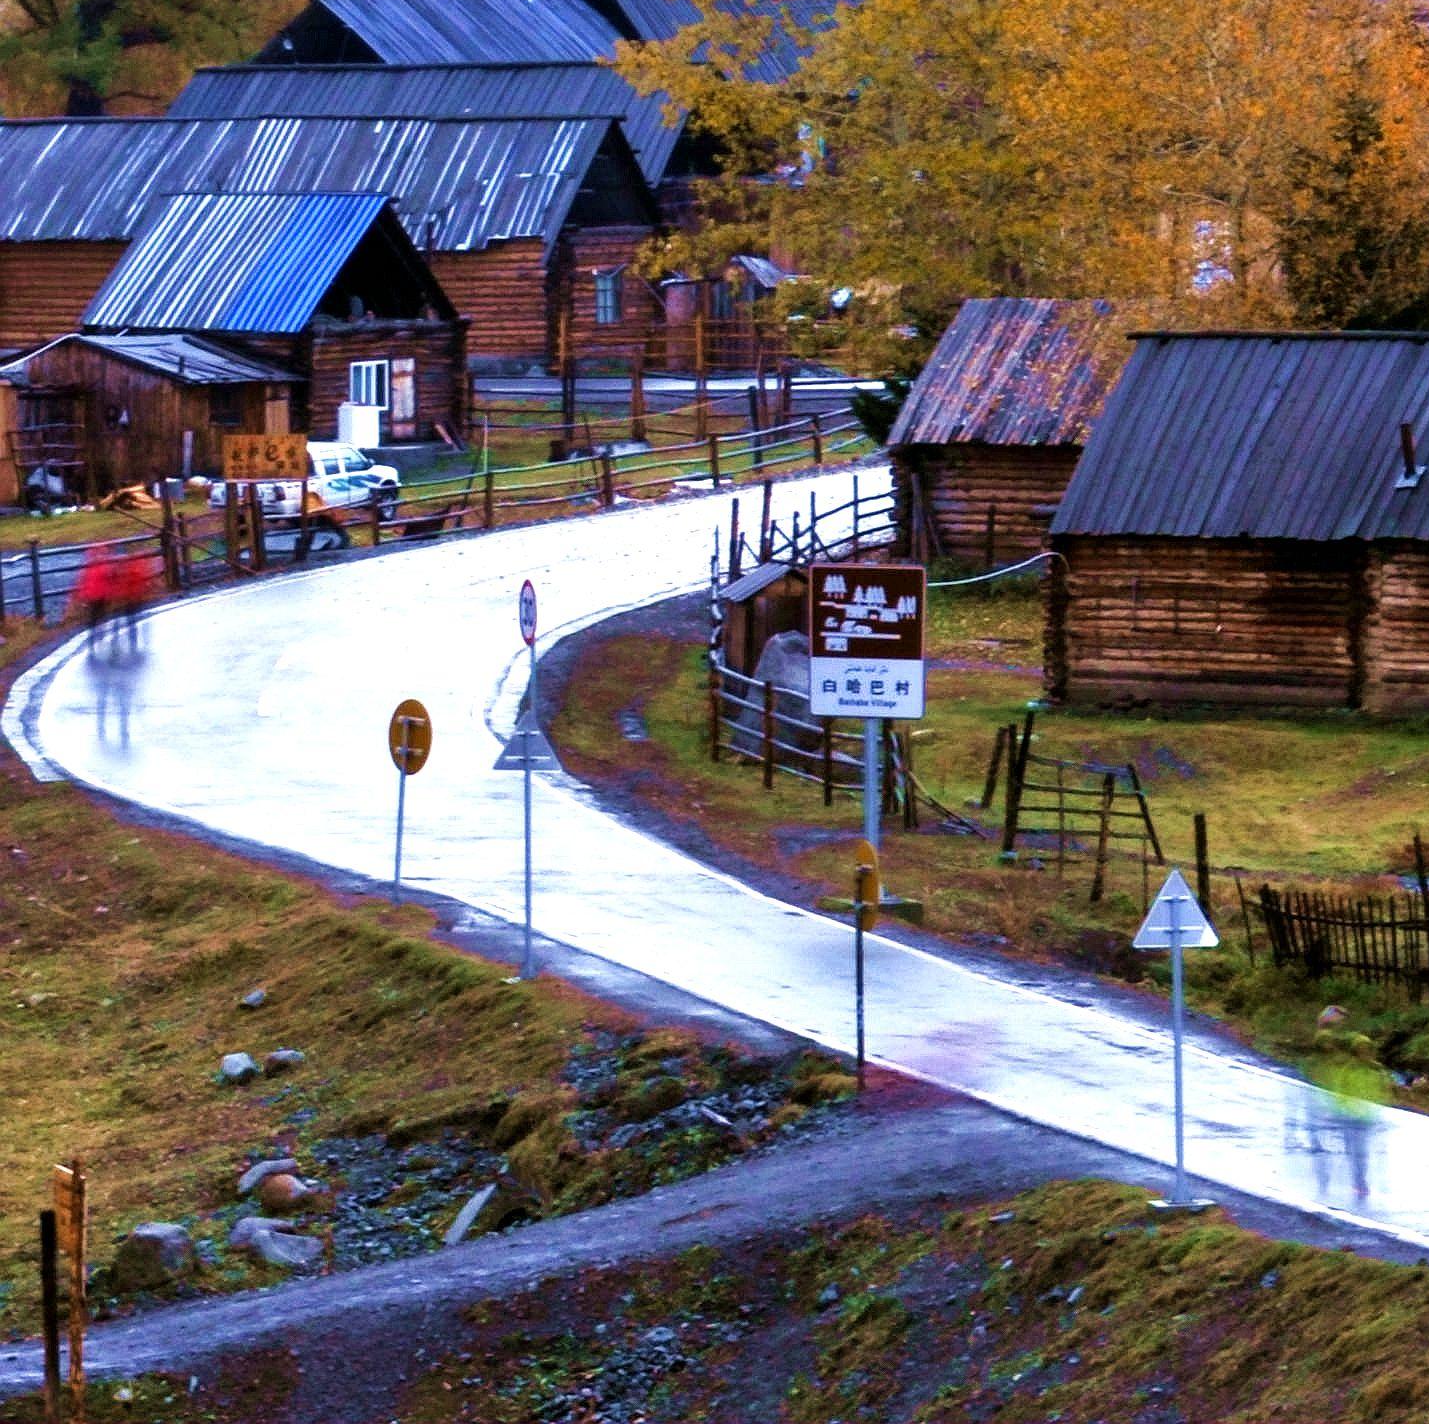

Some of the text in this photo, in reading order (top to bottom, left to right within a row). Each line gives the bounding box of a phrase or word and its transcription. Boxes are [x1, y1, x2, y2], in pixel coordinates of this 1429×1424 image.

[822, 678, 910, 696] 白哈巴村
[871, 699, 897, 709] Village
